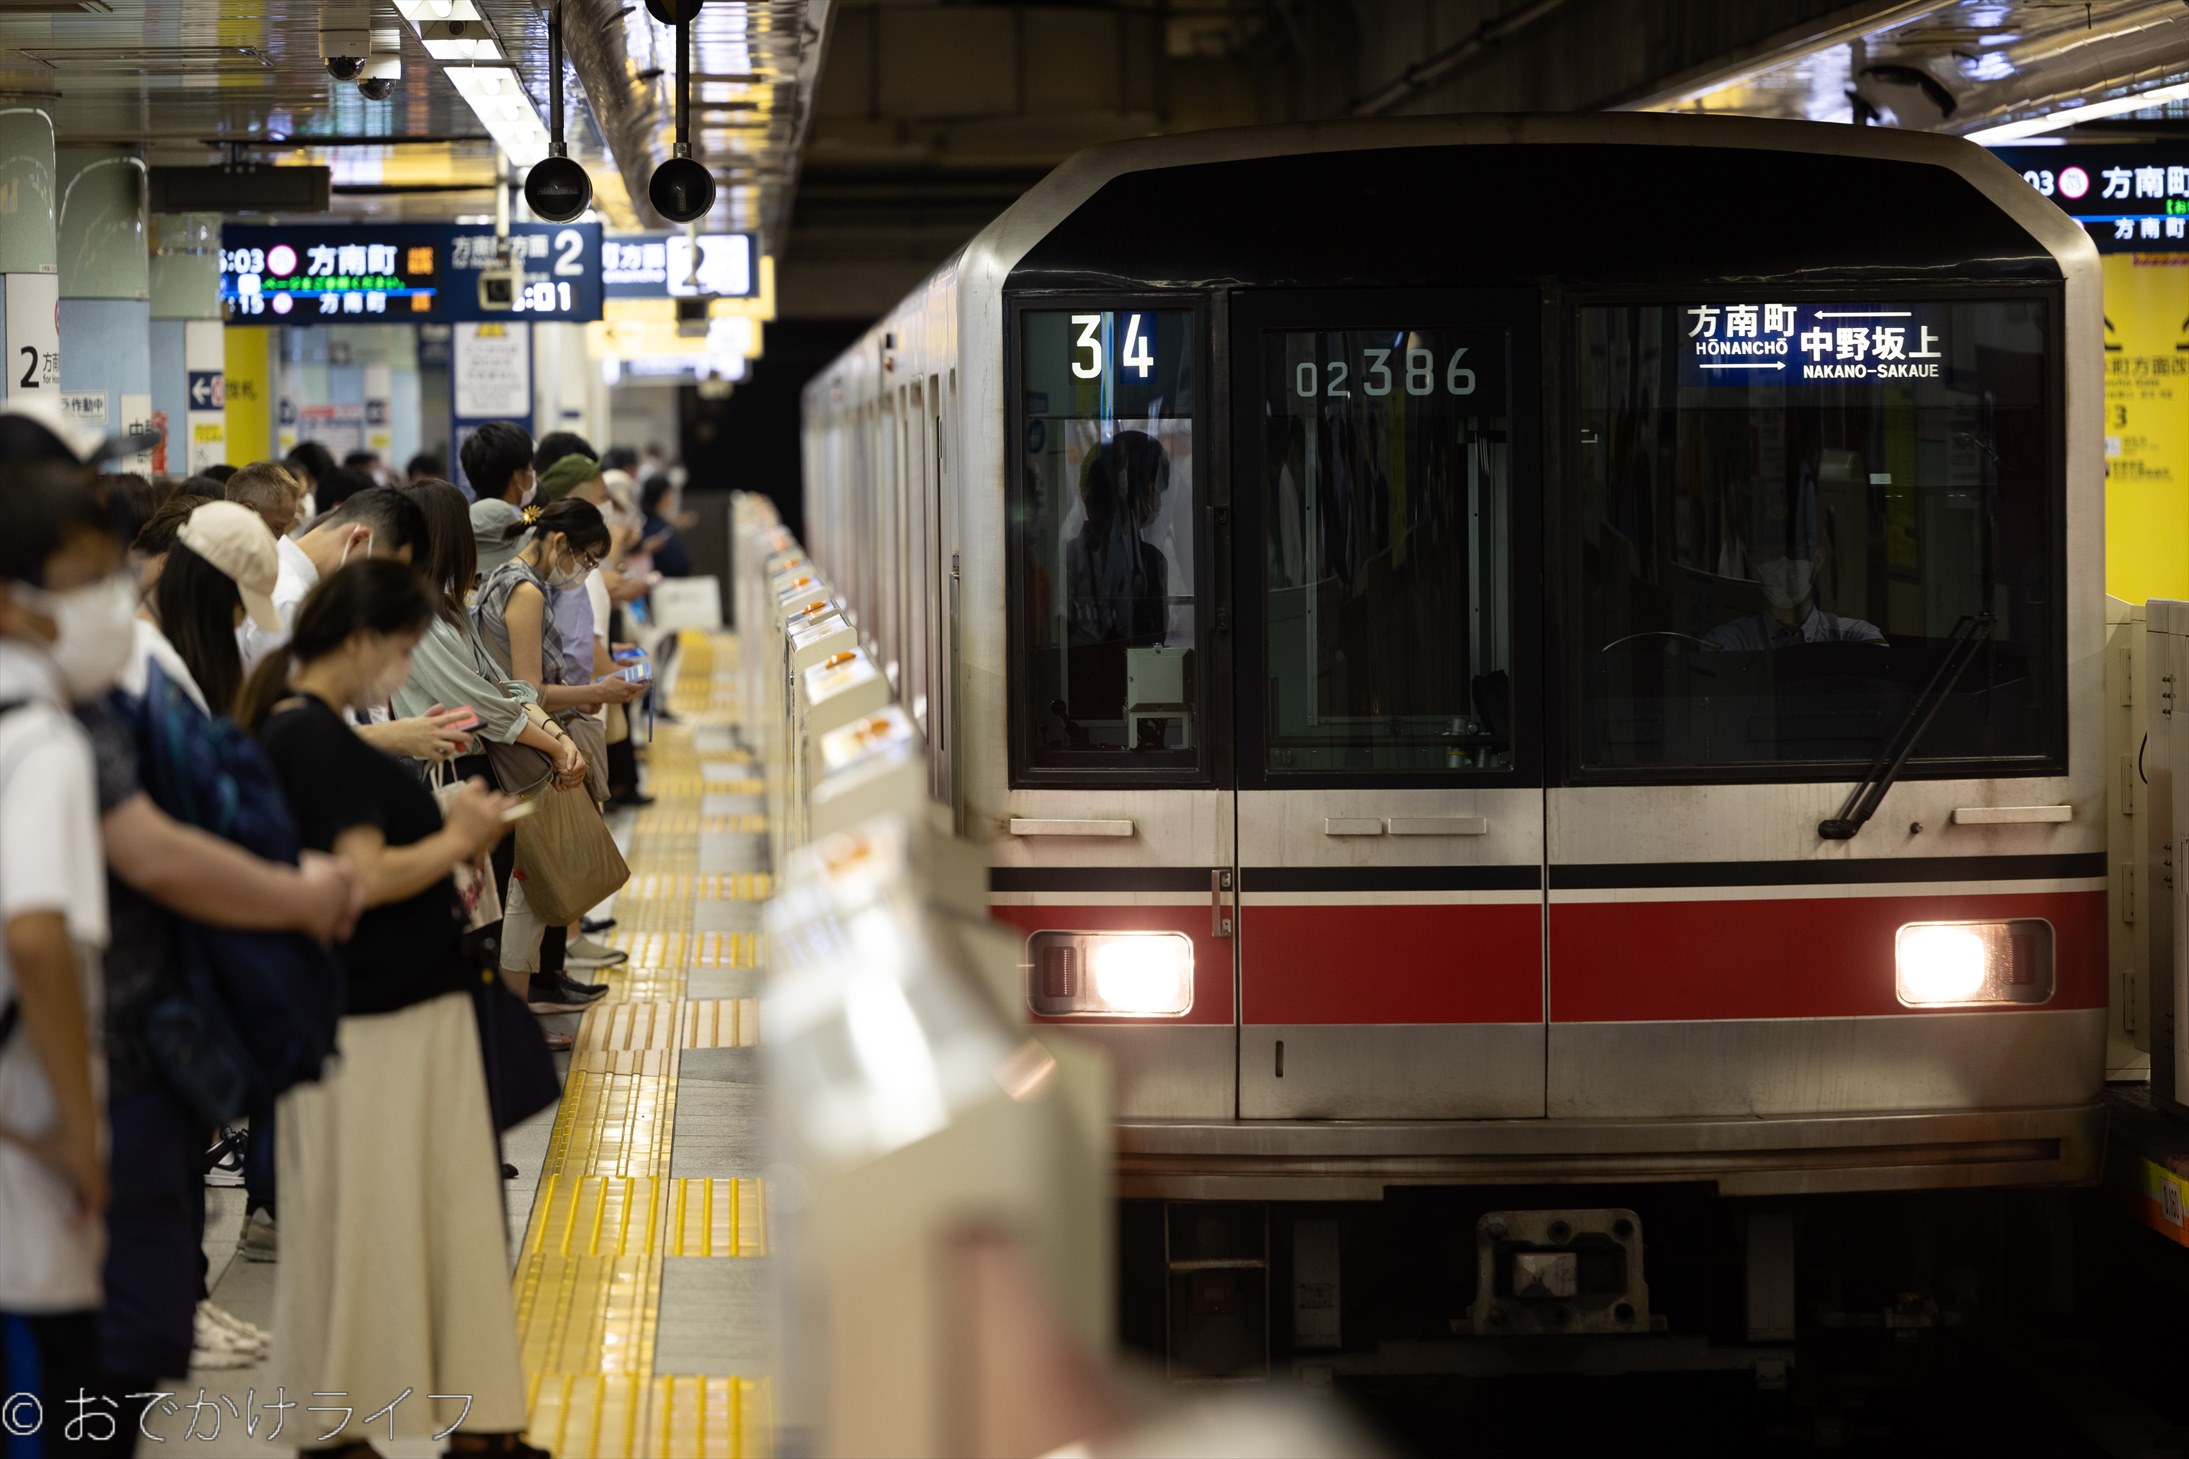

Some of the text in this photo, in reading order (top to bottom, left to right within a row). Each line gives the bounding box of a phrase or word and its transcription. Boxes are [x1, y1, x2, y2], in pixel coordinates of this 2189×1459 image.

[2102, 166, 2189, 199] 方南町
[2115, 216, 2185, 239] 方南町
[307, 244, 397, 276] 方南町
[554, 229, 584, 276] 2
[1687, 303, 1797, 338] 方南町
[1696, 338, 1788, 356] HŌNANCHŌ
[1800, 325, 1942, 362] 中野坂上
[20, 345, 39, 388] 2
[1803, 364, 1939, 379] NAKANO-SAKAUE
